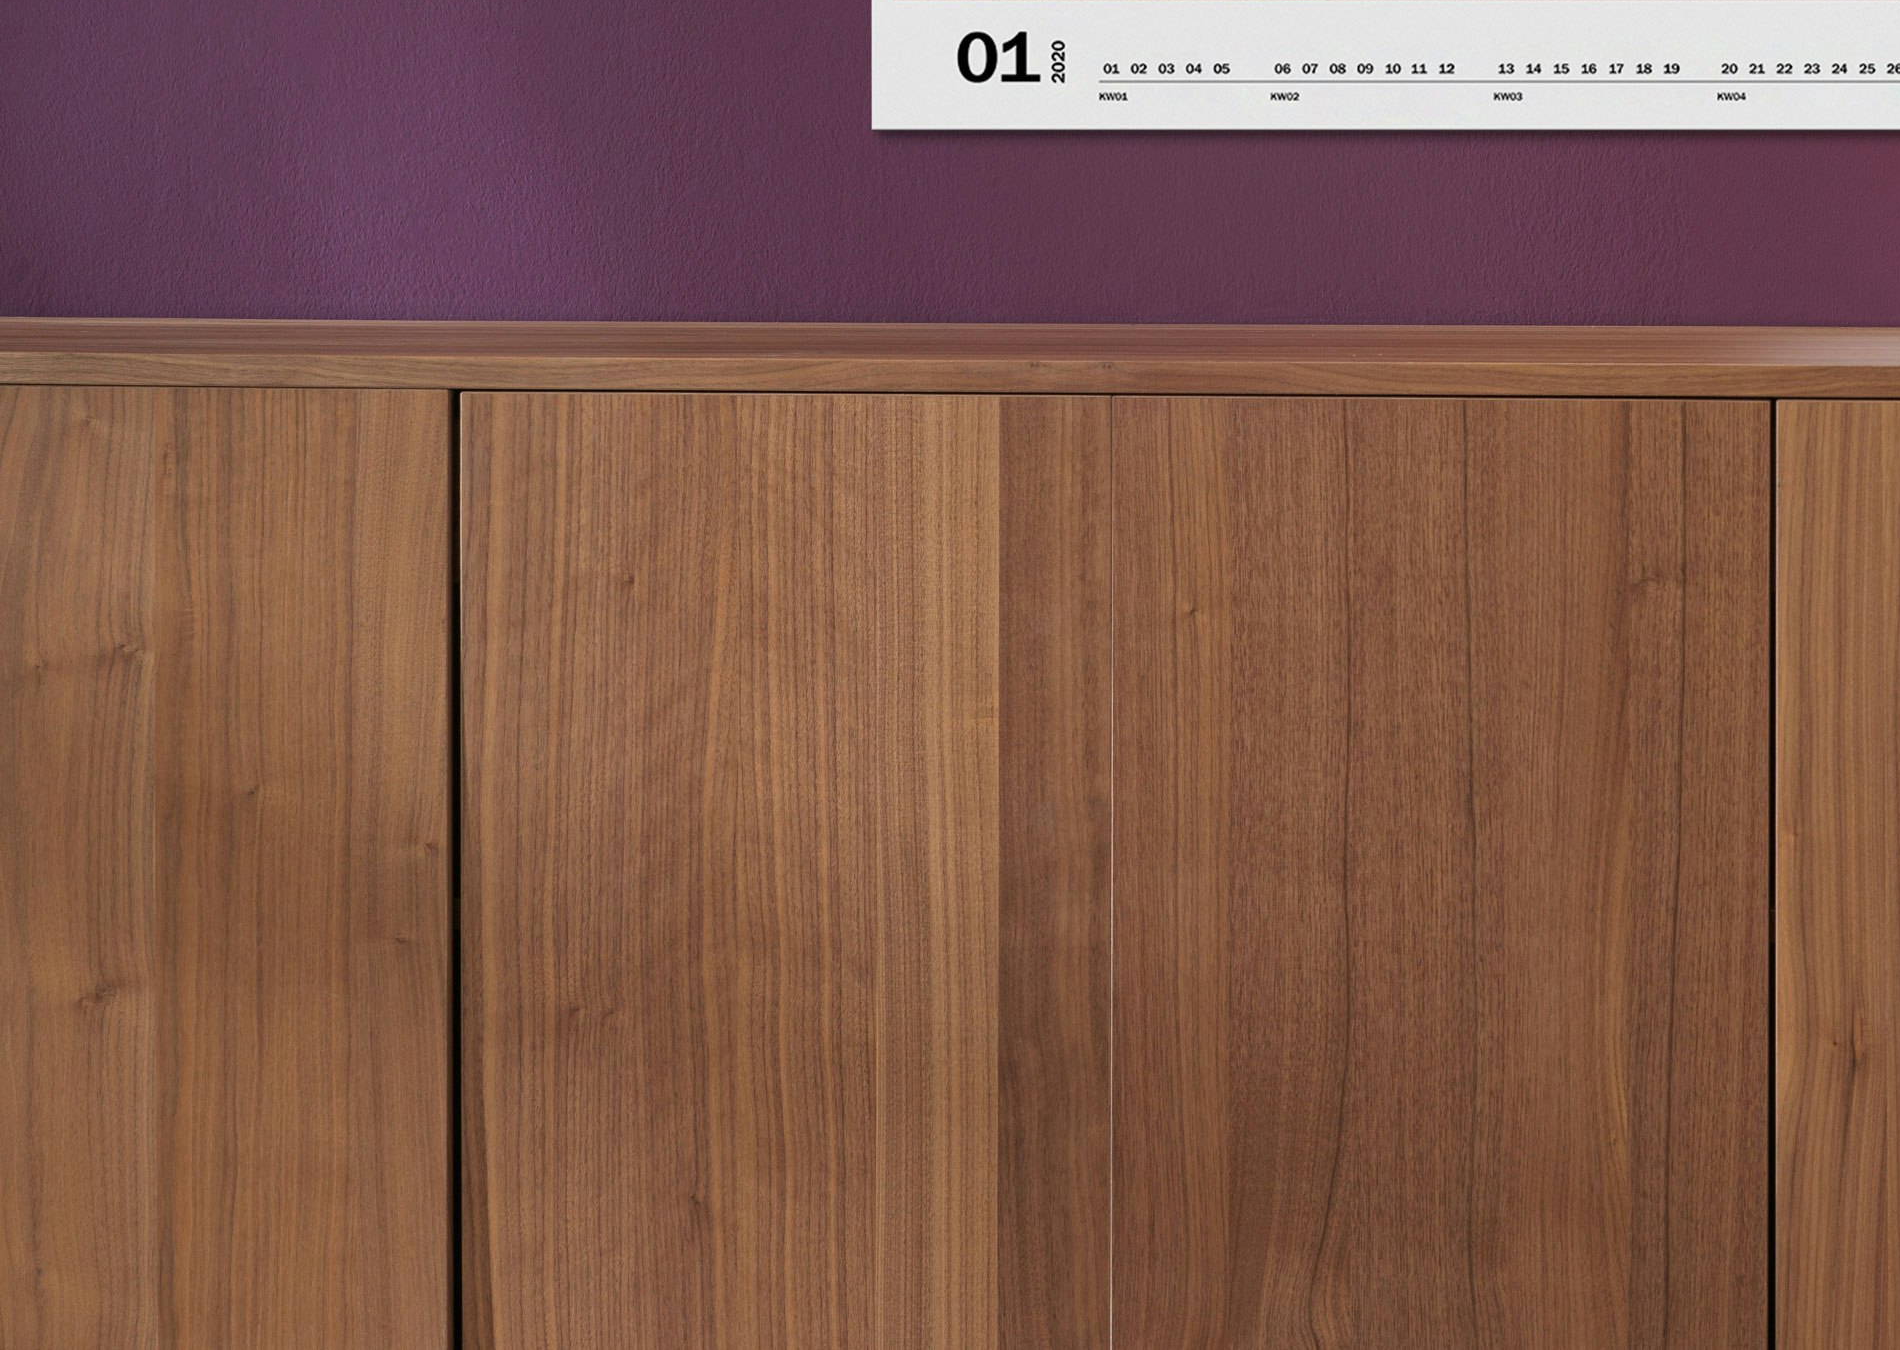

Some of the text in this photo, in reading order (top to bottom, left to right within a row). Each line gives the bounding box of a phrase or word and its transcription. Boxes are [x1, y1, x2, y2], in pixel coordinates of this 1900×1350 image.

[957, 31, 1042, 84] 01
[1050, 39, 1066, 84] 2020
[1102, 62, 1120, 75] 01
[1130, 62, 1148, 75] 02
[1157, 62, 1176, 75] 03
[1185, 62, 1203, 75] 04
[1213, 62, 1231, 75] 05
[1274, 62, 1292, 75] 06
[1301, 62, 1319, 75] 07
[1329, 62, 1347, 75] 08
[1356, 62, 1374, 75] 09
[1385, 62, 1402, 75] 10
[1411, 62, 1428, 75] 11
[1438, 62, 1455, 75] 12
[1498, 62, 1515, 75] 13
[1525, 62, 1542, 75] 14
[1553, 62, 1571, 75] 15
[1581, 62, 1598, 75] 16
[1609, 62, 1625, 75] 17
[1636, 62, 1653, 75] 18
[1663, 62, 1681, 75] 19
[1721, 62, 1739, 75] 20
[1748, 62, 1766, 75] 21
[1776, 62, 1794, 75] 22
[1803, 62, 1821, 75] 23
[1831, 62, 1848, 75] 24
[1858, 62, 1877, 75] 25
[1098, 91, 1128, 102] KW01
[1270, 91, 1300, 102] KW02
[1493, 91, 1523, 102] KW03
[1716, 91, 1747, 102] KW04
